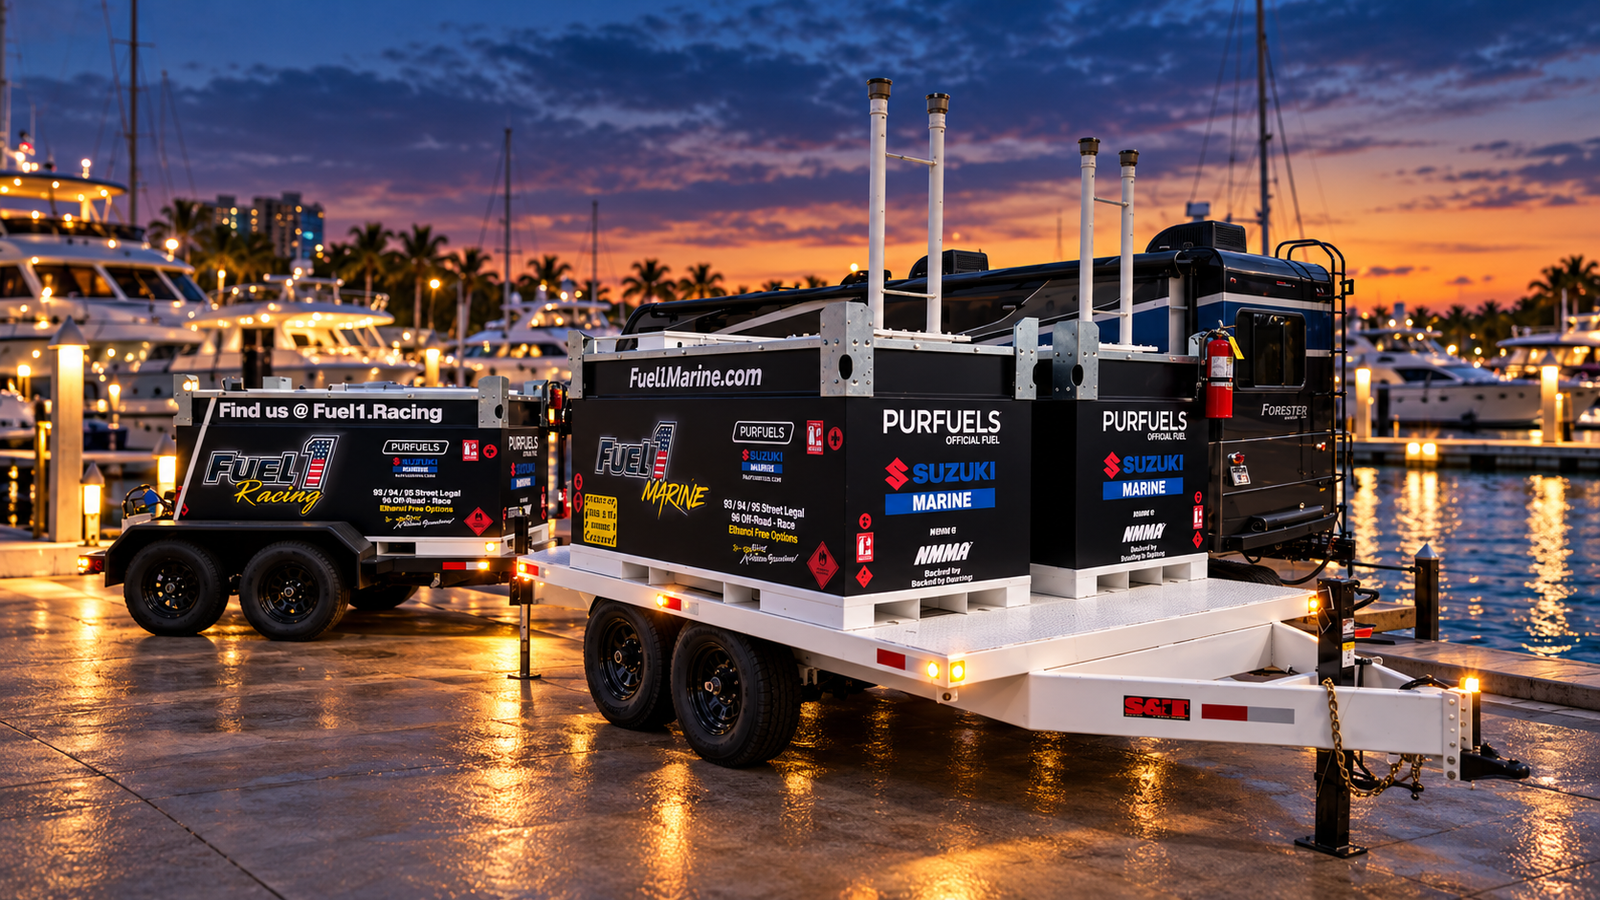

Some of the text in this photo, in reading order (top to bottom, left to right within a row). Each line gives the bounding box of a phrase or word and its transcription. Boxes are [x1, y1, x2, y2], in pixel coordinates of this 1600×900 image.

[629, 364, 762, 388] Fuel1Marine.com
[219, 402, 442, 423] Find us @ Fuel1.Racing
[883, 409, 1001, 434] PURFUELS
[1103, 410, 1187, 432] PURFUELS
[740, 426, 784, 439] PURFUELS
[946, 435, 1000, 445] OFFICIAL FUEL
[391, 443, 440, 452] PURFUELS
[750, 451, 783, 462] SUZUKI
[912, 461, 995, 484] SUZUKI
[1122, 454, 1184, 474] SUZUKI
[234, 479, 324, 514] Racing
[373, 488, 383, 496] 93
[1122, 480, 1166, 497] MARINE
[641, 480, 709, 520] MARINE
[723, 499, 733, 510] 93
[737, 500, 746, 511] 94
[761, 503, 783, 516] Street
[784, 507, 805, 520] Legal
[912, 491, 972, 512] MARINE
[777, 519, 796, 530] Race
[1122, 522, 1167, 543] NMMA
[754, 528, 769, 540] Free
[770, 530, 798, 544] Options
[913, 541, 974, 566] NMMA
